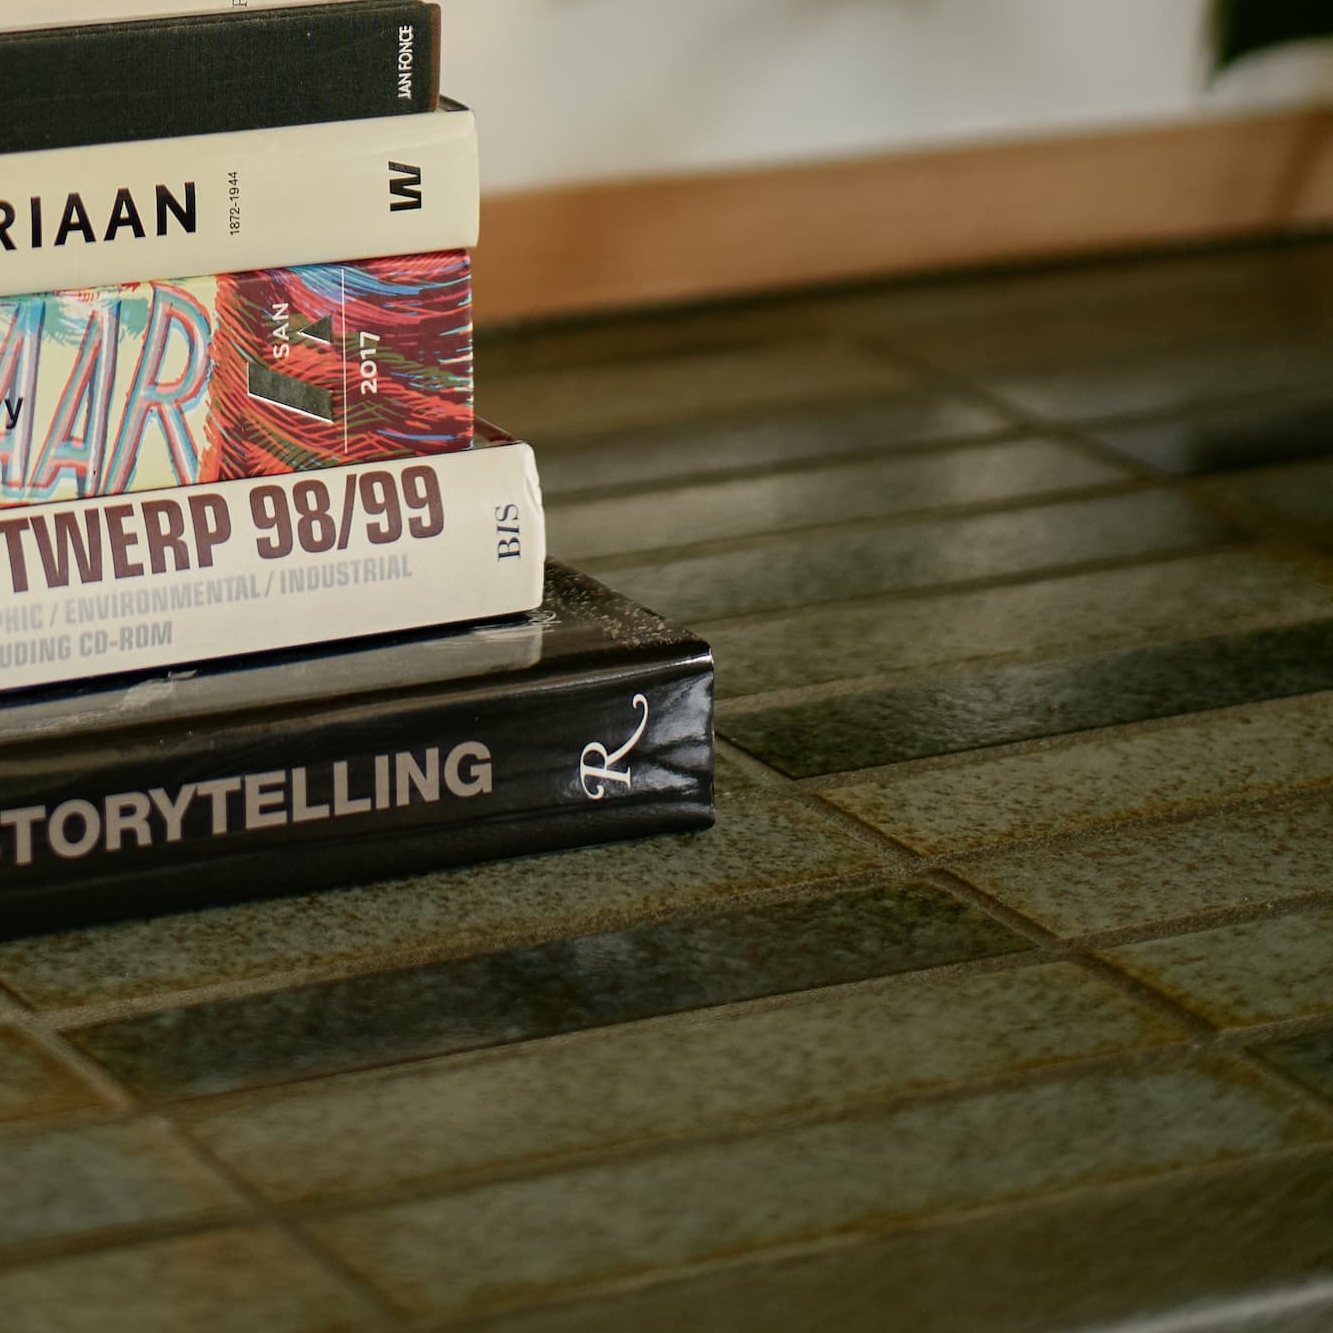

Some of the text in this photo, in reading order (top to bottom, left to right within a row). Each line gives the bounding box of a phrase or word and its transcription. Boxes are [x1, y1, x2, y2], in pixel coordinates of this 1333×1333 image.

[398, 24, 414, 100] JAN FONCE
[228, 170, 240, 236] 1872-1944
[388, 160, 422, 212] W
[272, 302, 290, 358] SAN
[359, 331, 380, 395] 2017
[249, 464, 445, 560] 98/99
[494, 502, 522, 562] BIS
[65, 575, 261, 628] ENVIRONMENTAL
[279, 553, 413, 596] INDUSTRIAL
[78, 620, 173, 659] CD-ROM
[579, 693, 649, 801] R
